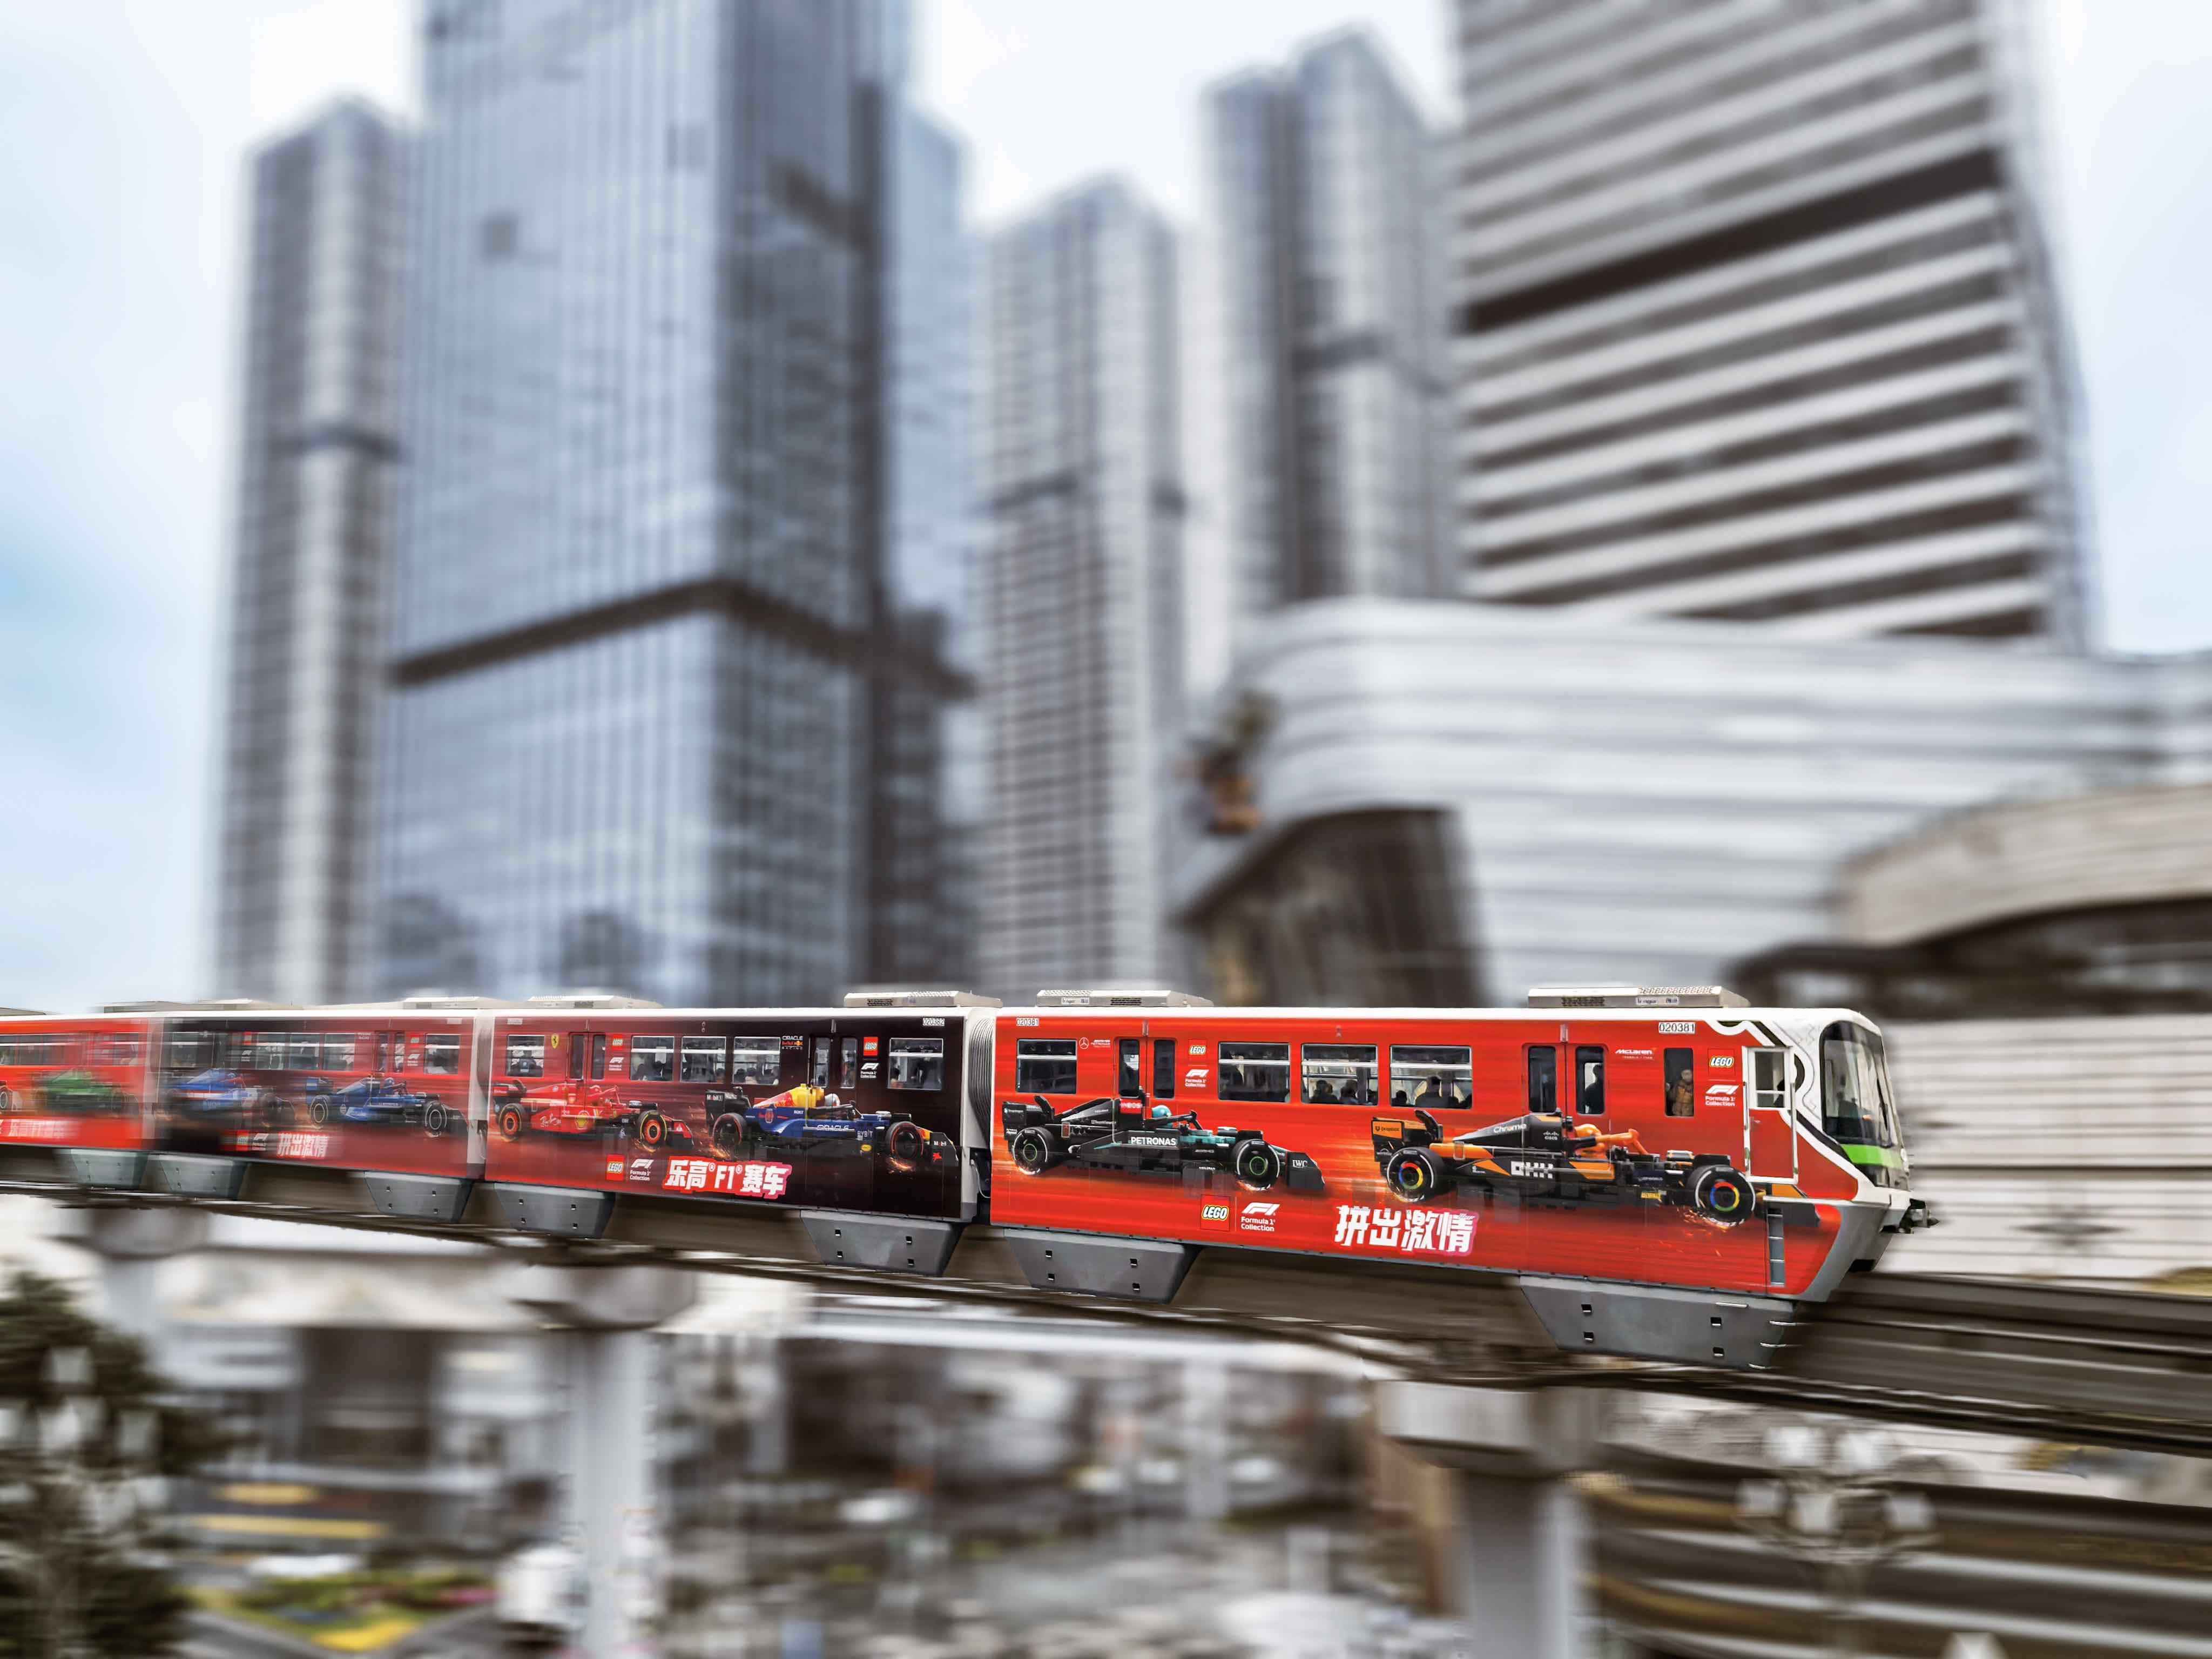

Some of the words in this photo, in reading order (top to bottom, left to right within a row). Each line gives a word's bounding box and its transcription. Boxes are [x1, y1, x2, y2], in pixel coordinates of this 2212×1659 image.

[1659, 1023, 1695, 1033] 020381
[1190, 1046, 1206, 1054] LEGO
[1710, 1057, 1734, 1067] LEGO
[1494, 1123, 1527, 1133] Chrome
[1131, 1137, 1176, 1145] PETRONAS
[608, 1163, 623, 1172] LEGO
[1292, 1159, 1308, 1168] IWC
[1203, 1205, 1228, 1220] LEGO
[1241, 1223, 1274, 1231] Collection
[1334, 1205, 1475, 1253] 拼出激情
